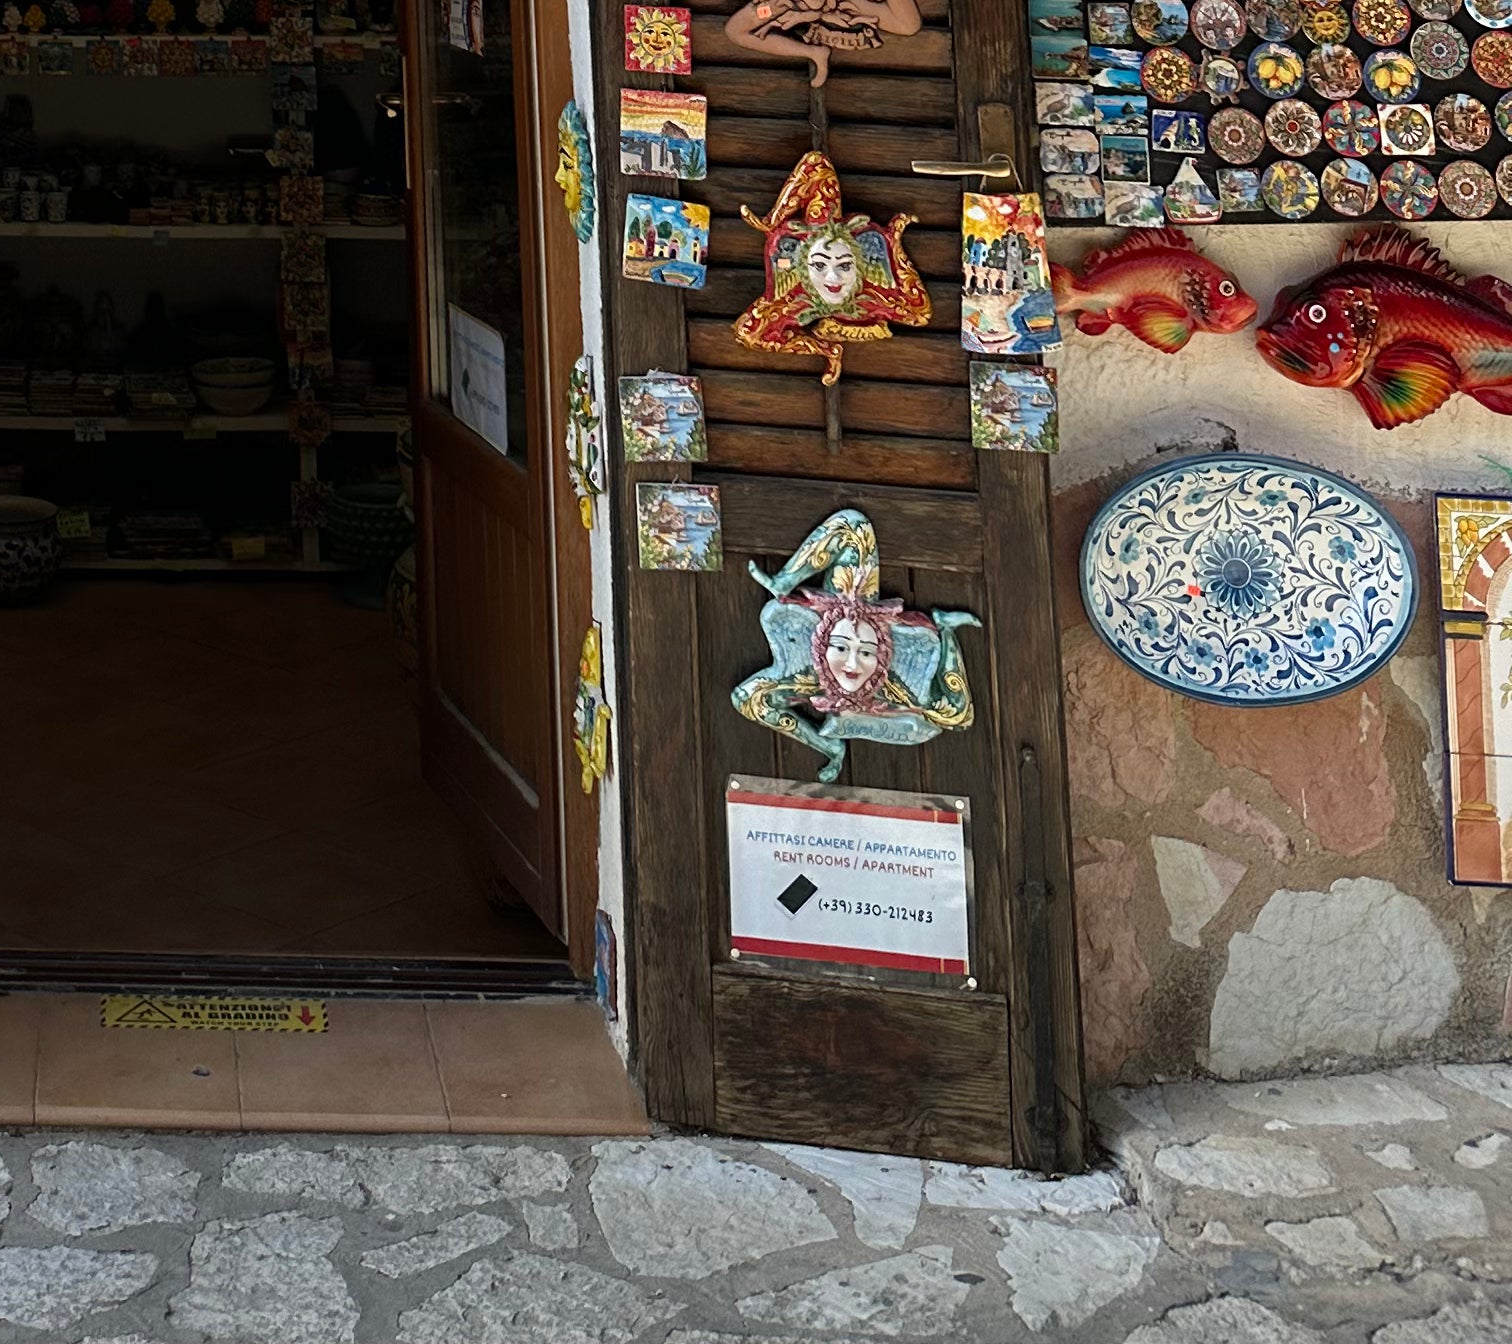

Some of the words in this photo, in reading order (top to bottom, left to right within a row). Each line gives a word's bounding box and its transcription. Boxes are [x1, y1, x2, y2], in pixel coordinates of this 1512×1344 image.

[746, 829, 806, 846] AFFITTASI
[808, 835, 855, 850] CAMERE
[864, 841, 957, 862] APPARTAMENTO
[773, 850, 804, 864] RENT
[807, 853, 851, 868] ROOMS
[862, 859, 935, 879] APARTMENT
[818, 898, 852, 915] (+39)
[855, 902, 934, 924] 330-212483
